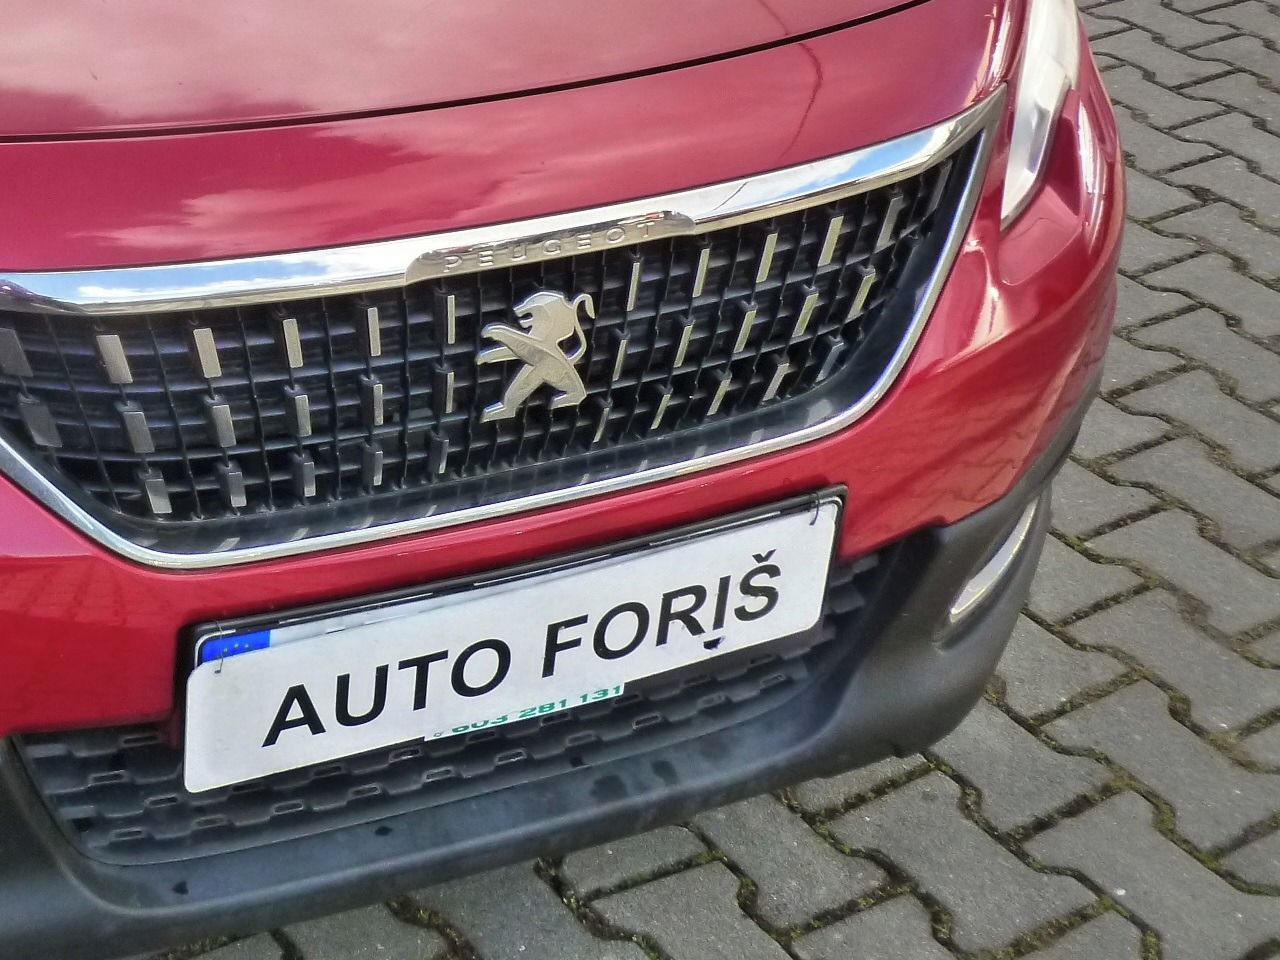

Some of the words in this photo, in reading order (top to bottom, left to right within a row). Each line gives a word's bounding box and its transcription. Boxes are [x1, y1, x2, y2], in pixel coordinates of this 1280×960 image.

[442, 221, 656, 273] PEUGEOT
[262, 638, 511, 748] AUTO
[541, 549, 781, 679] FORIŠ
[519, 698, 568, 718] 281
[578, 685, 621, 704] 131
